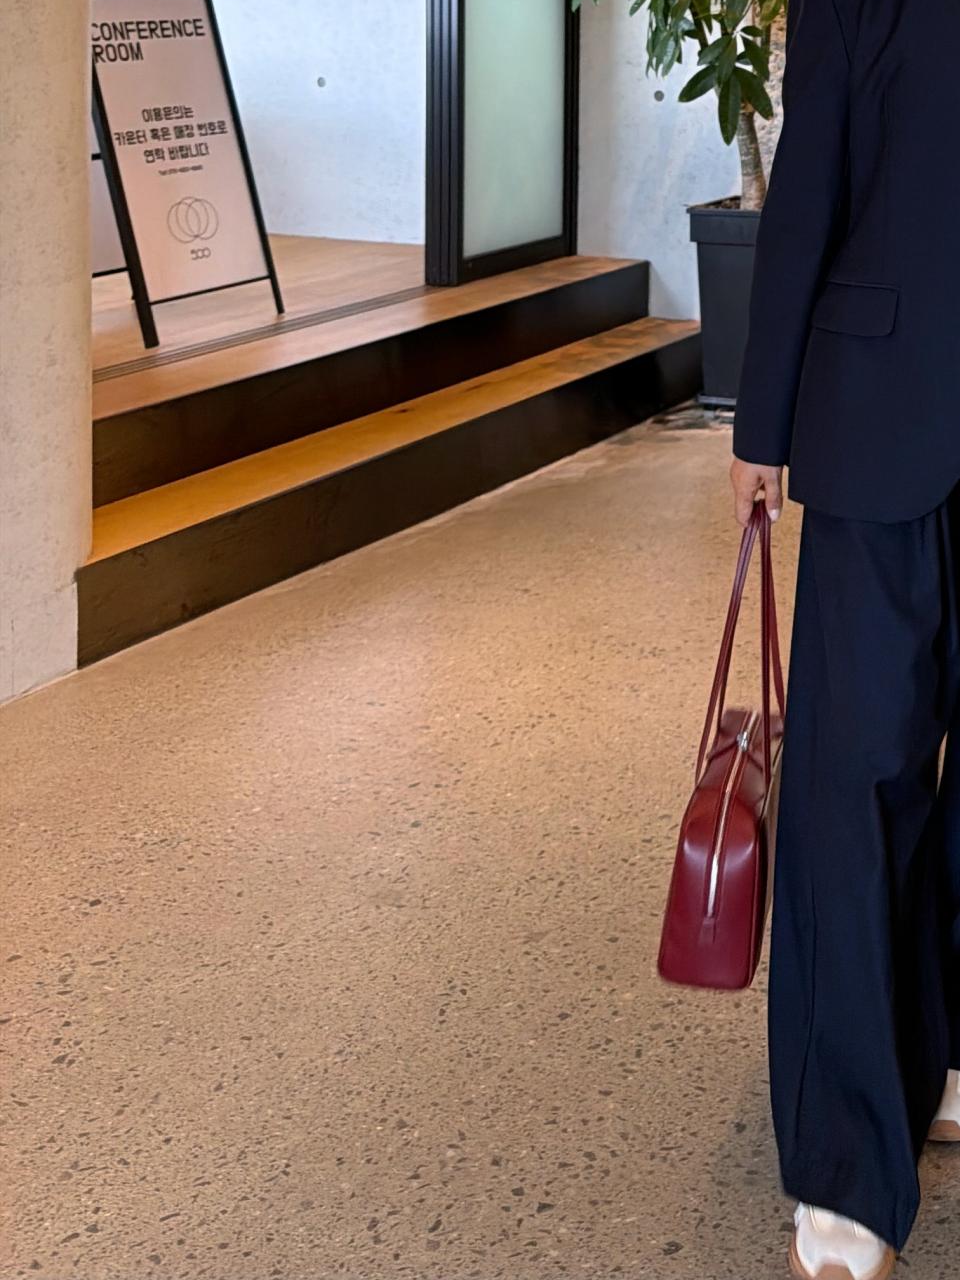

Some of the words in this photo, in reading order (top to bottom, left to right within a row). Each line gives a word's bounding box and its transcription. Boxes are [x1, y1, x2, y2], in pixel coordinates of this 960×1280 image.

[92, 42, 144, 63] ROOM
[113, 129, 148, 146] 카운터
[167, 142, 210, 161] 바랍니다
